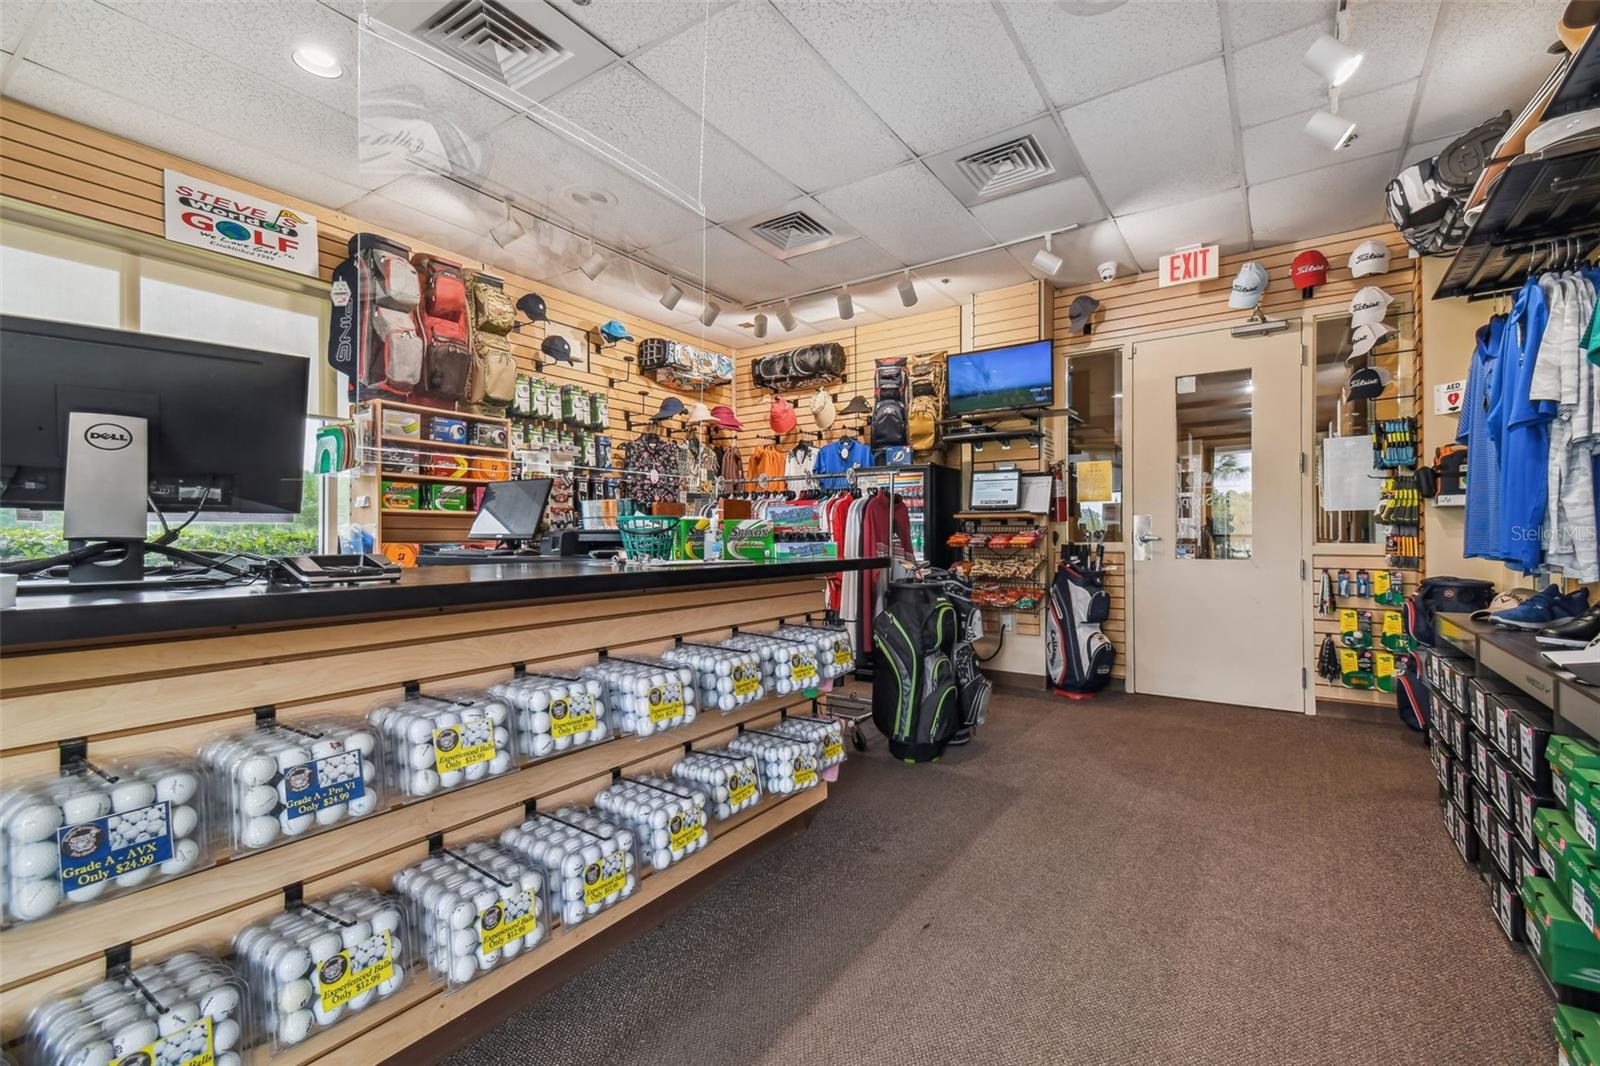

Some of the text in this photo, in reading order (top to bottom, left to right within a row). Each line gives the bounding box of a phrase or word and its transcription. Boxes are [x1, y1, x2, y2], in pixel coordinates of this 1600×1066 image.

[189, 198, 254, 228] World
[181, 212, 299, 252] GOLF
[200, 231, 216, 240] We
[220, 236, 250, 248] Love
[210, 240, 254, 256] Established
[1355, 252, 1385, 264] Titleist
[1170, 248, 1210, 282] EXIT
[1296, 264, 1324, 276] Titleist
[1352, 301, 1380, 312] Titleist
[1350, 379, 1378, 388] Titleist
[1446, 382, 1460, 390] AED
[90, 432, 128, 442] DELL
[440, 743, 492, 764] Experienced Balls
[446, 760, 461, 769] Only
[286, 796, 312, 808] Grade
[329, 787, 344, 795] Pro
[298, 792, 350, 814] Only $24.99
[62, 861, 102, 878] Grade
[105, 856, 115, 866] A
[127, 842, 157, 858] AVX
[77, 854, 155, 885] Only $24.99
[484, 914, 535, 944] Experienced Balls
[489, 938, 504, 948] Only
[324, 961, 392, 1000] Experienced Balls
[332, 973, 380, 1004] Only $12.99
